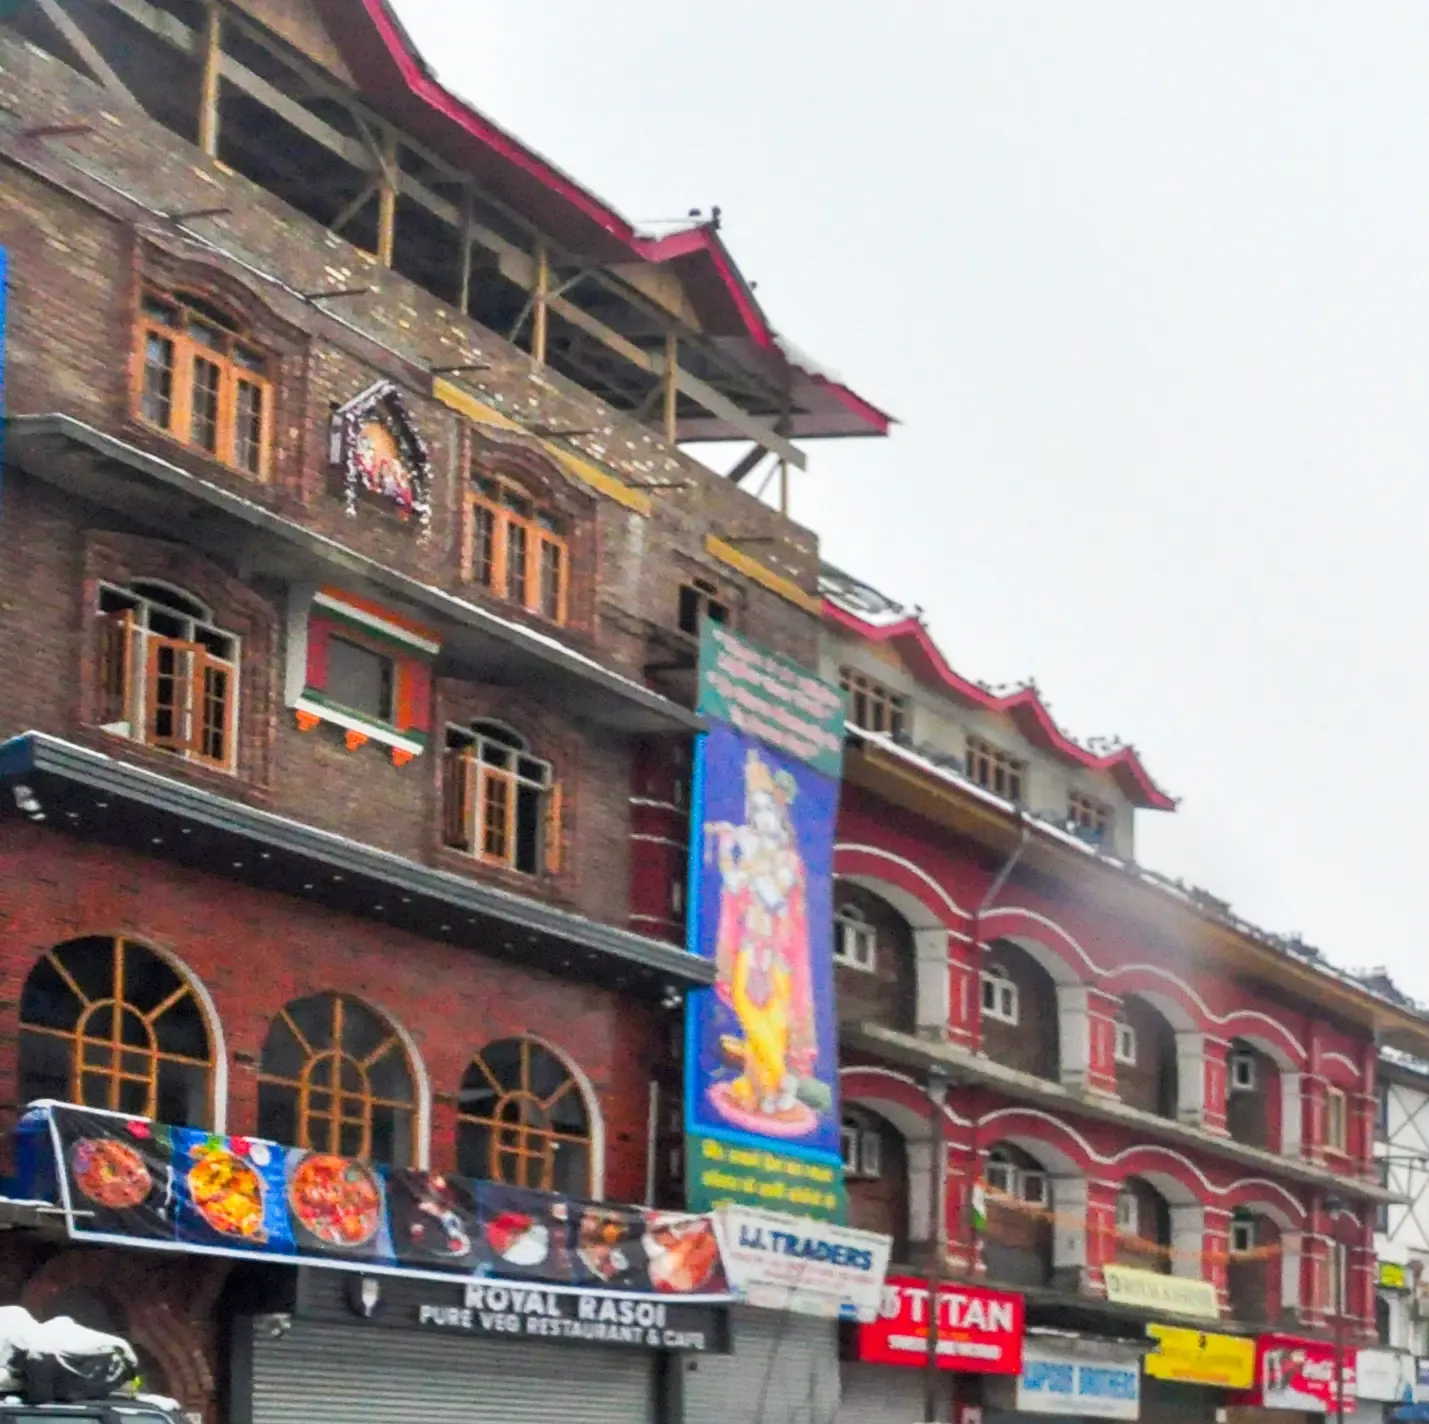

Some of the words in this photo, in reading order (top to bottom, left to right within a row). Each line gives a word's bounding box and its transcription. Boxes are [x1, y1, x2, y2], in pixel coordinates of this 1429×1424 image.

[769, 1230, 873, 1270] TRADERS
[419, 1305, 473, 1327] PURE
[479, 1310, 520, 1333] VEG
[526, 1315, 643, 1343] RESTAURANT
[464, 1283, 561, 1317] ROYAL
[578, 1296, 667, 1327] RASOI
